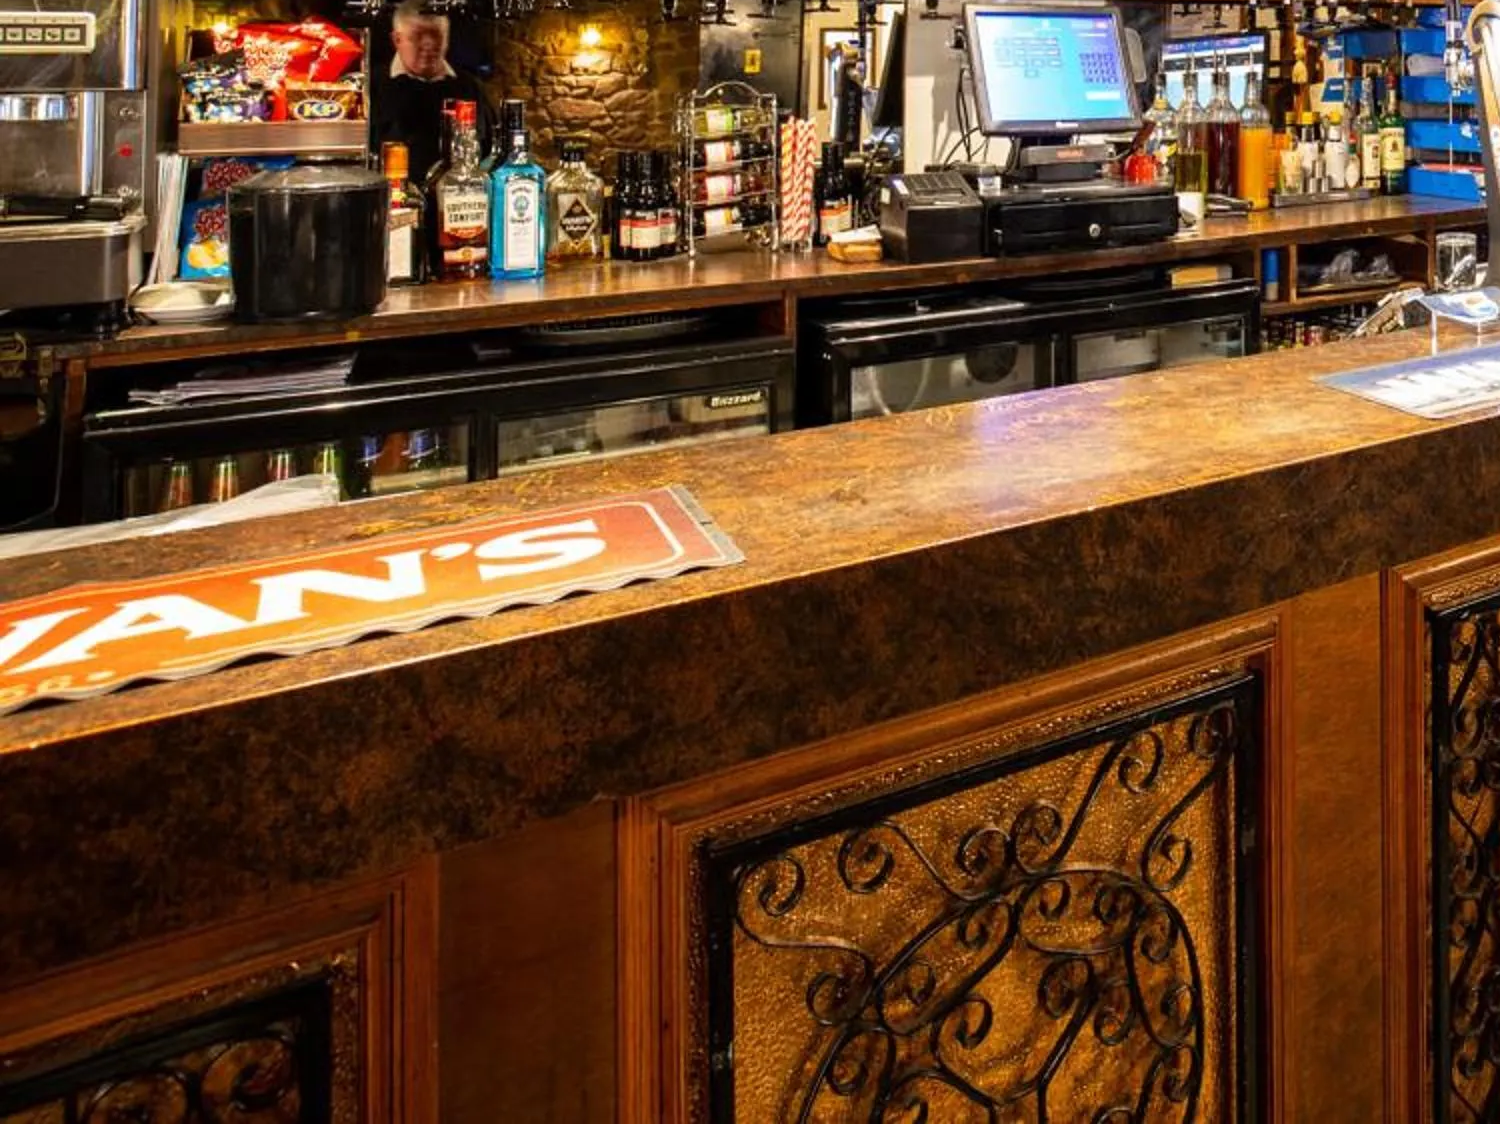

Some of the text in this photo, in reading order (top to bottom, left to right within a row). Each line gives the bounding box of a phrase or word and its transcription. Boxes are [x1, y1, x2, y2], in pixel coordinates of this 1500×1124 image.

[303, 103, 340, 118] KP
[446, 202, 487, 213] SOUTHERN
[449, 212, 485, 224] COMFORT
